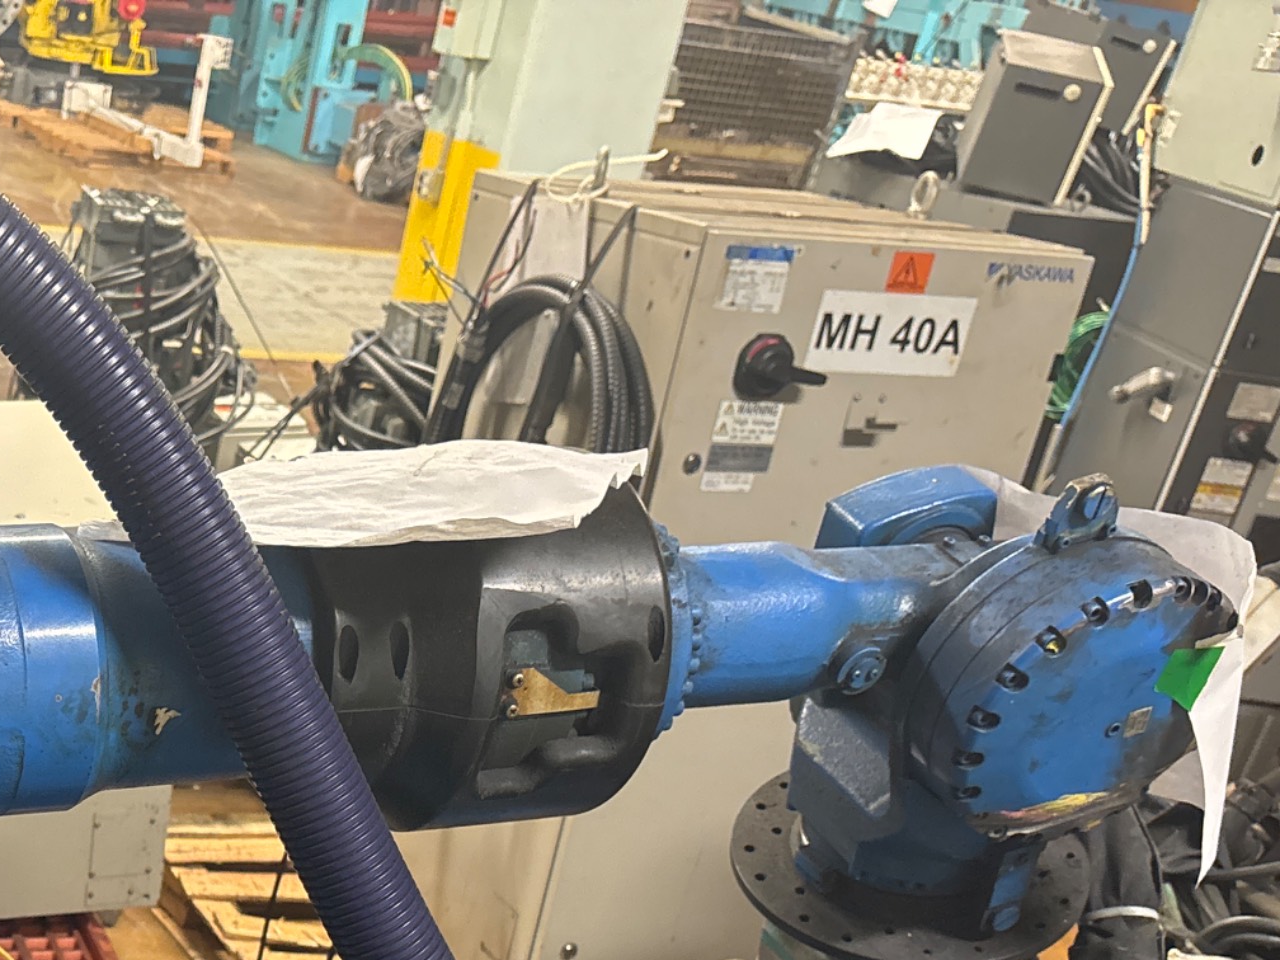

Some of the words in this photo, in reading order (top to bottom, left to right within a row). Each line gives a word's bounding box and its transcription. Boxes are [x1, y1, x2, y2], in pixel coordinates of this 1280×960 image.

[1006, 263, 1074, 283] YASKAWA
[814, 312, 881, 351] MH
[889, 316, 960, 355] 40A
